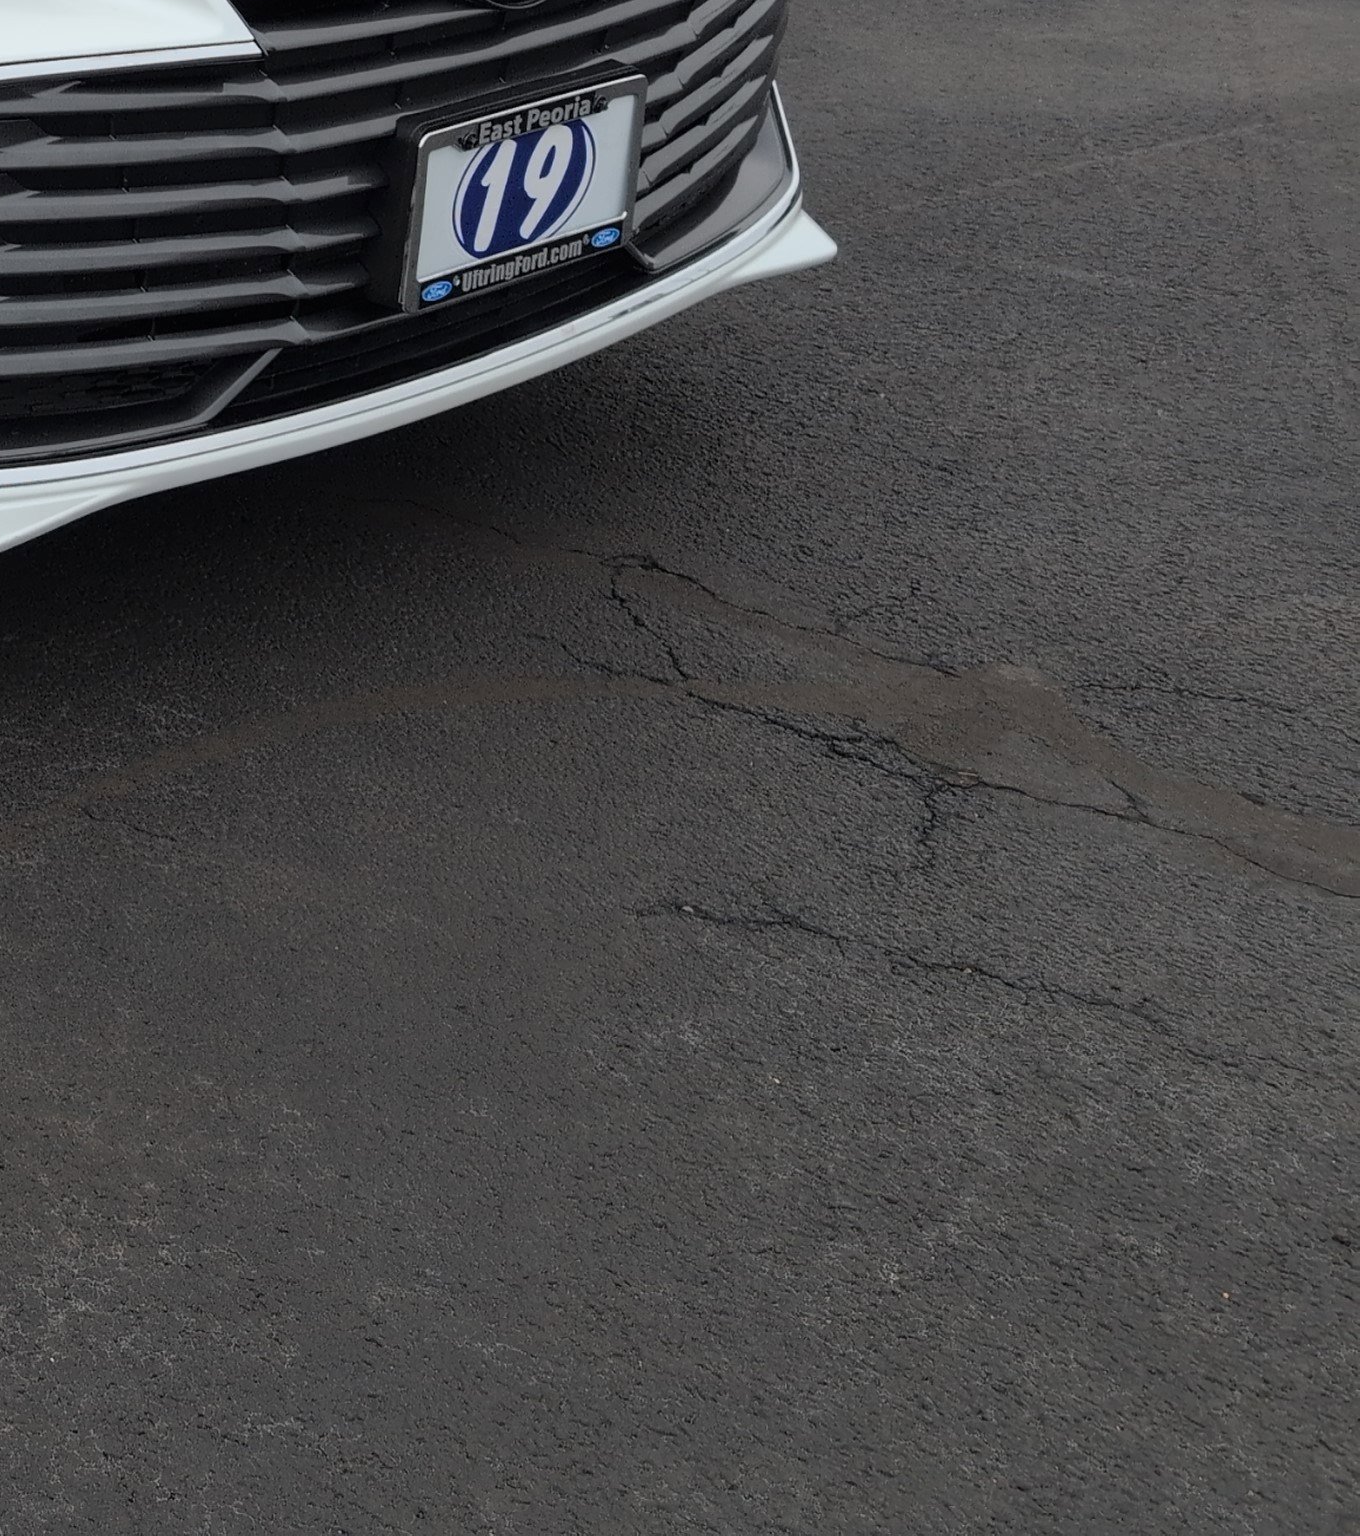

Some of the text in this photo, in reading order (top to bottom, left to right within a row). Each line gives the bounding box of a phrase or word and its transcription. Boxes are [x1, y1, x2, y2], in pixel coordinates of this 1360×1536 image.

[479, 96, 591, 144] East Peoria
[474, 124, 574, 252] 19
[461, 239, 583, 293] UftringFord.com
